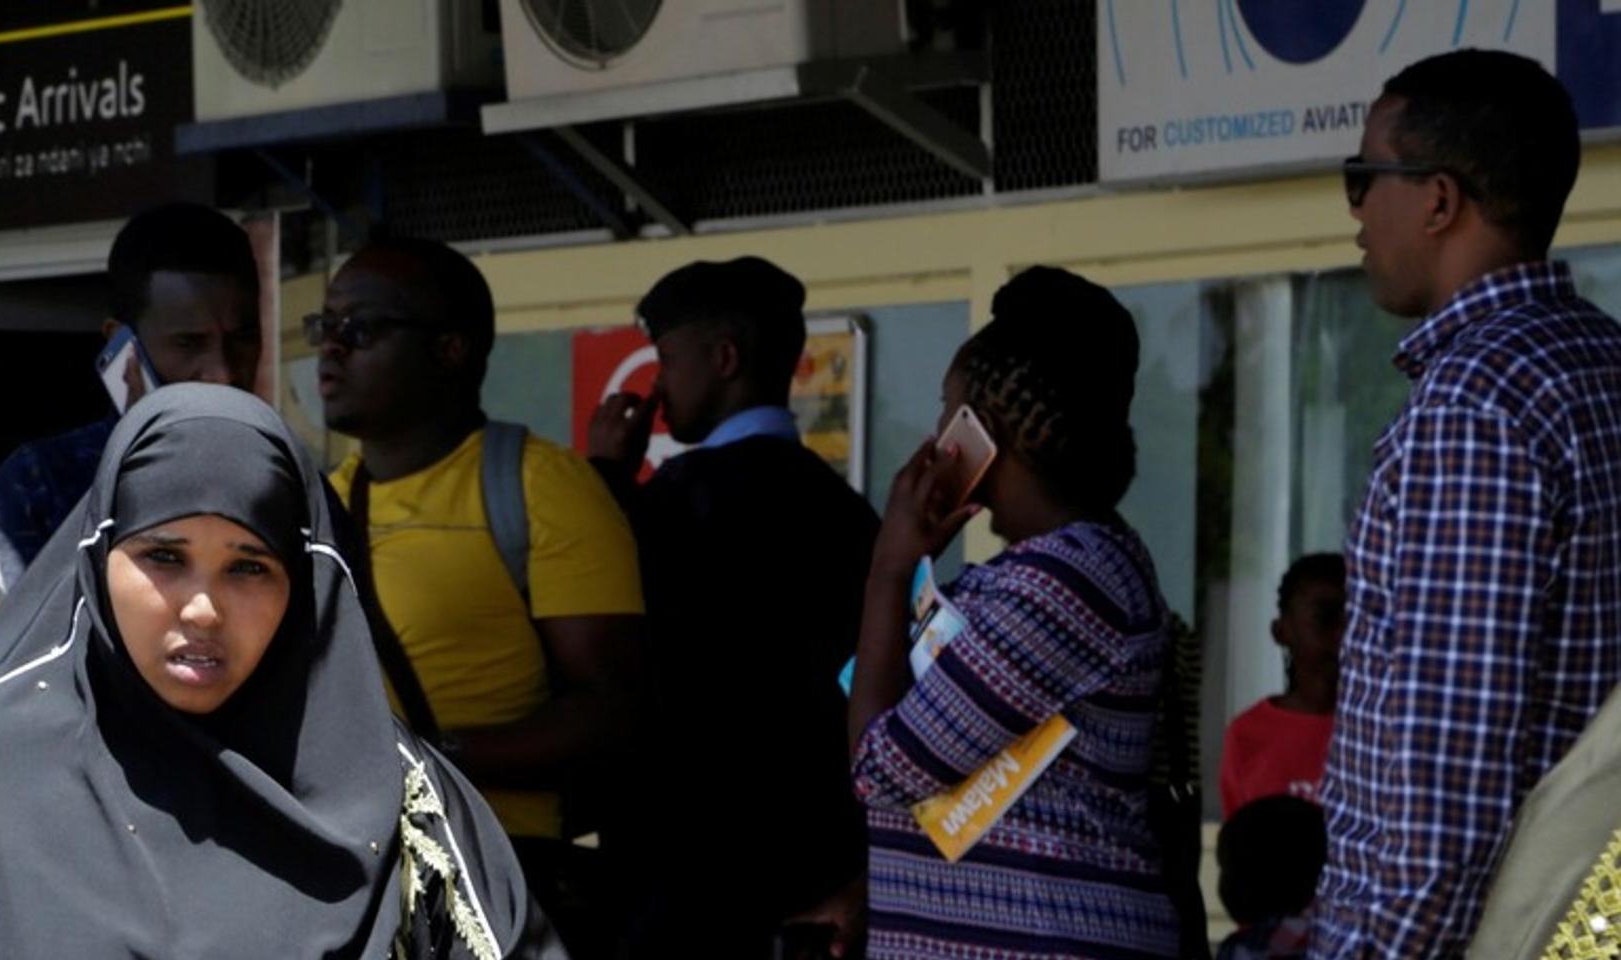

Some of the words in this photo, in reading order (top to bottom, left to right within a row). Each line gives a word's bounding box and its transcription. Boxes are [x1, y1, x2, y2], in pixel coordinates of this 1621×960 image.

[14, 59, 146, 128] Arrivals
[1116, 126, 1159, 154] FOR
[1164, 108, 1296, 147] CUSTOMIZED
[942, 750, 1021, 836] Malawi
